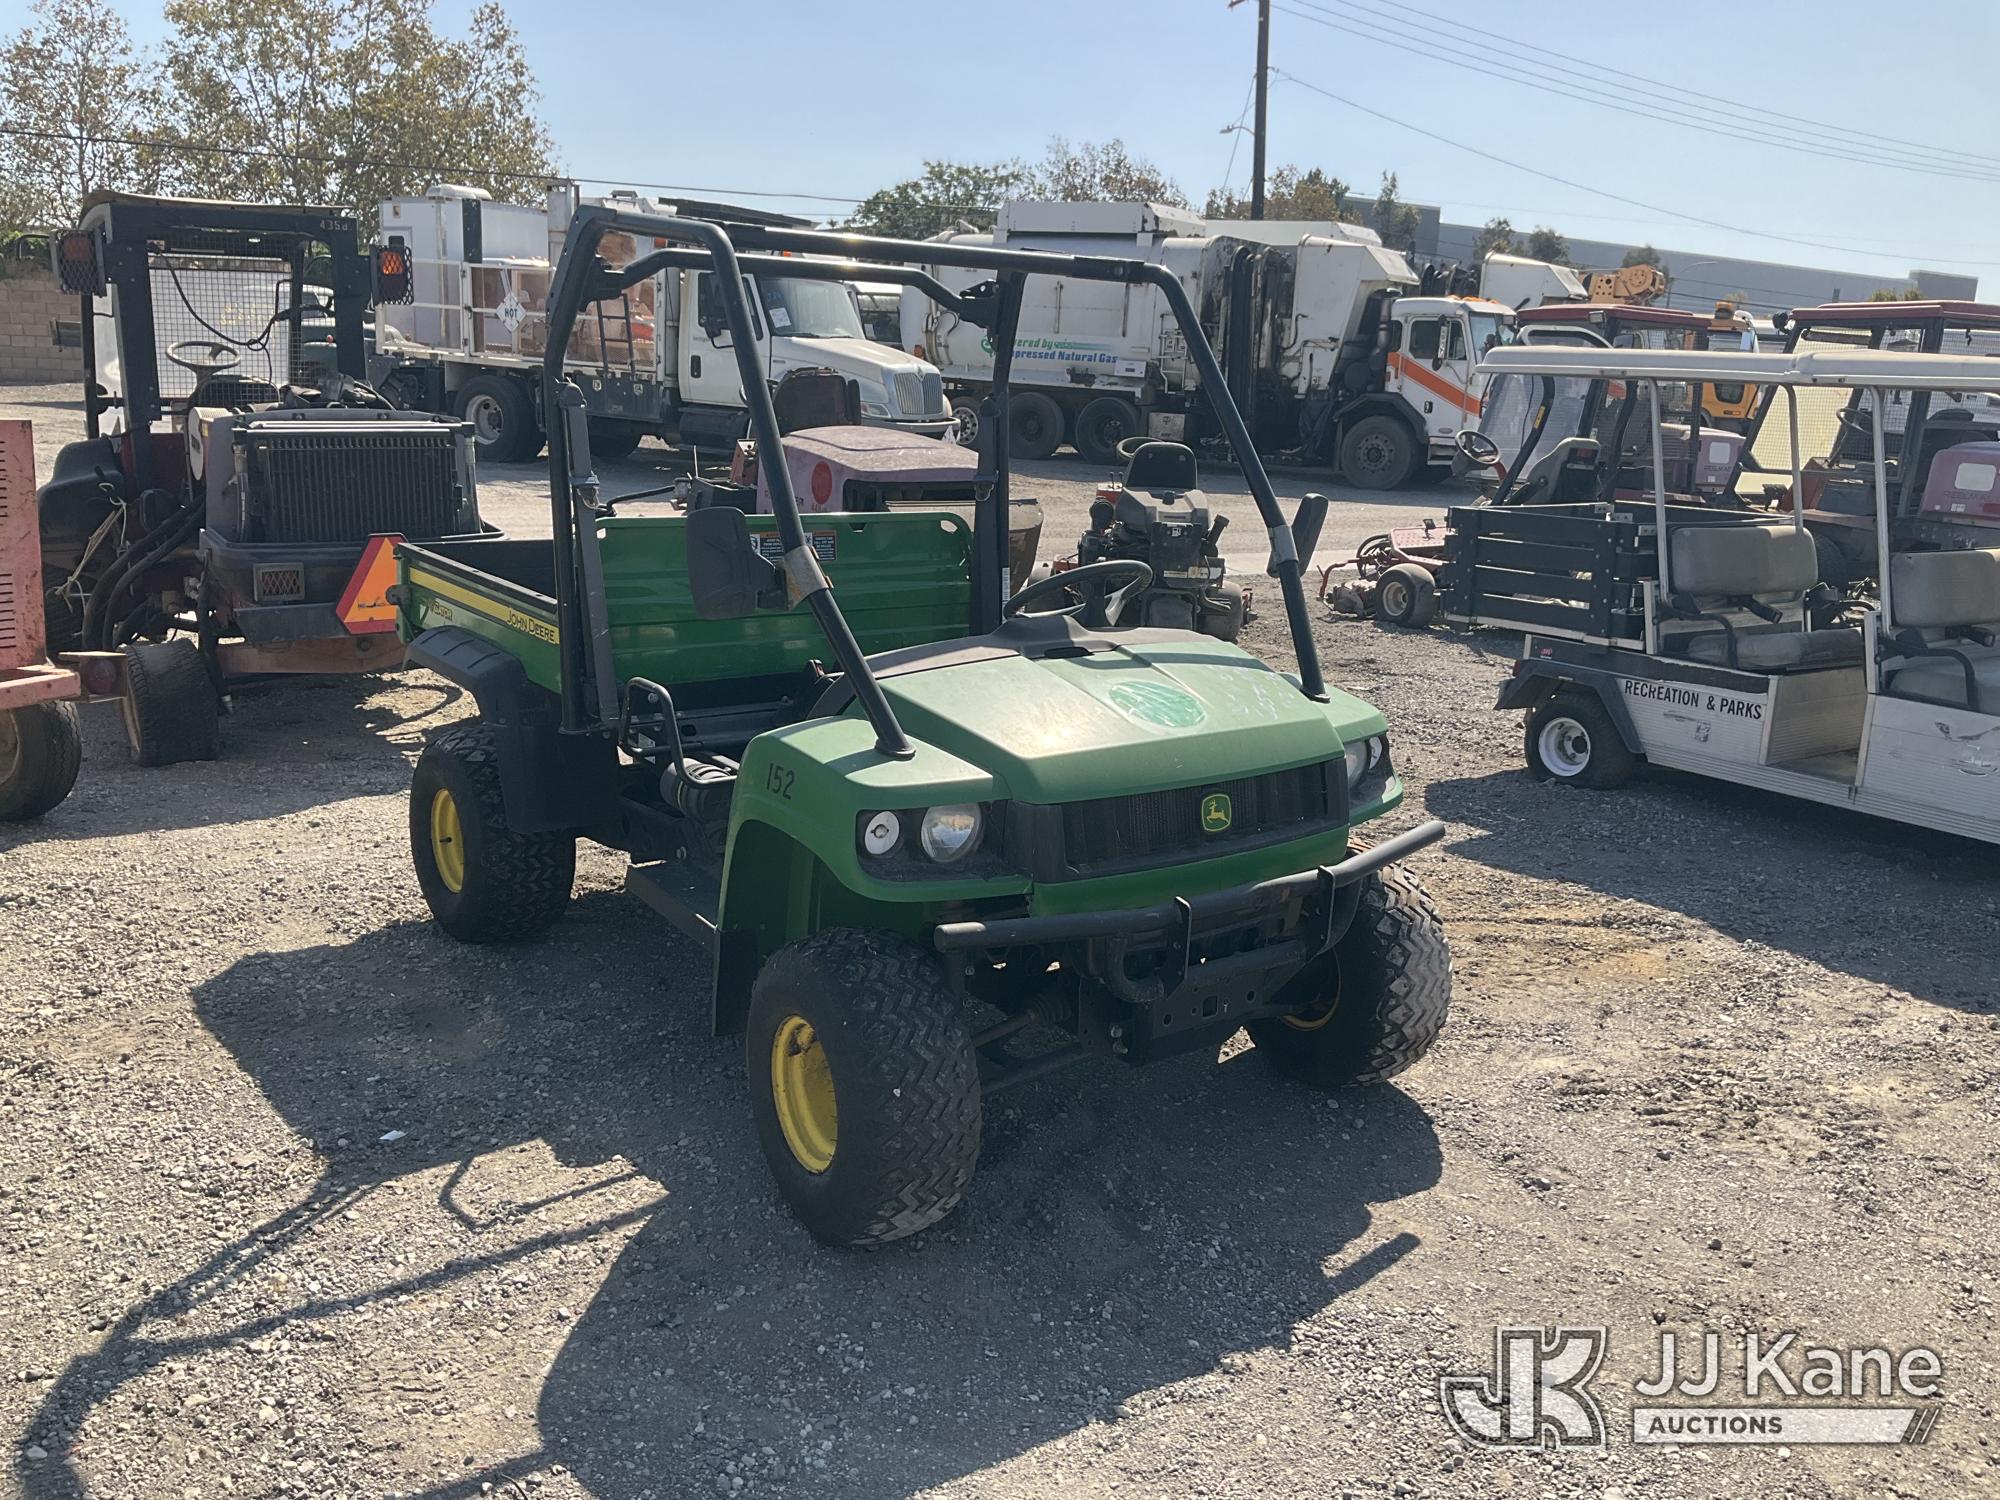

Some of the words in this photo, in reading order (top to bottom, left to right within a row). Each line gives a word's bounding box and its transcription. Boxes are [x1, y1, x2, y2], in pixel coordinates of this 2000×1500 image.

[504, 308, 518, 318] HOT
[1043, 337, 1053, 350] by
[1012, 350, 1056, 360] pressed
[1057, 350, 1097, 363] Natural
[1099, 353, 1118, 364] Gas
[507, 609, 528, 632] JOHN
[528, 618, 556, 642] DEERE
[1624, 680, 1699, 707] RECREATION
[1706, 695, 1716, 711] &
[1719, 697, 1762, 720] PARKS
[766, 762, 795, 800] 152
